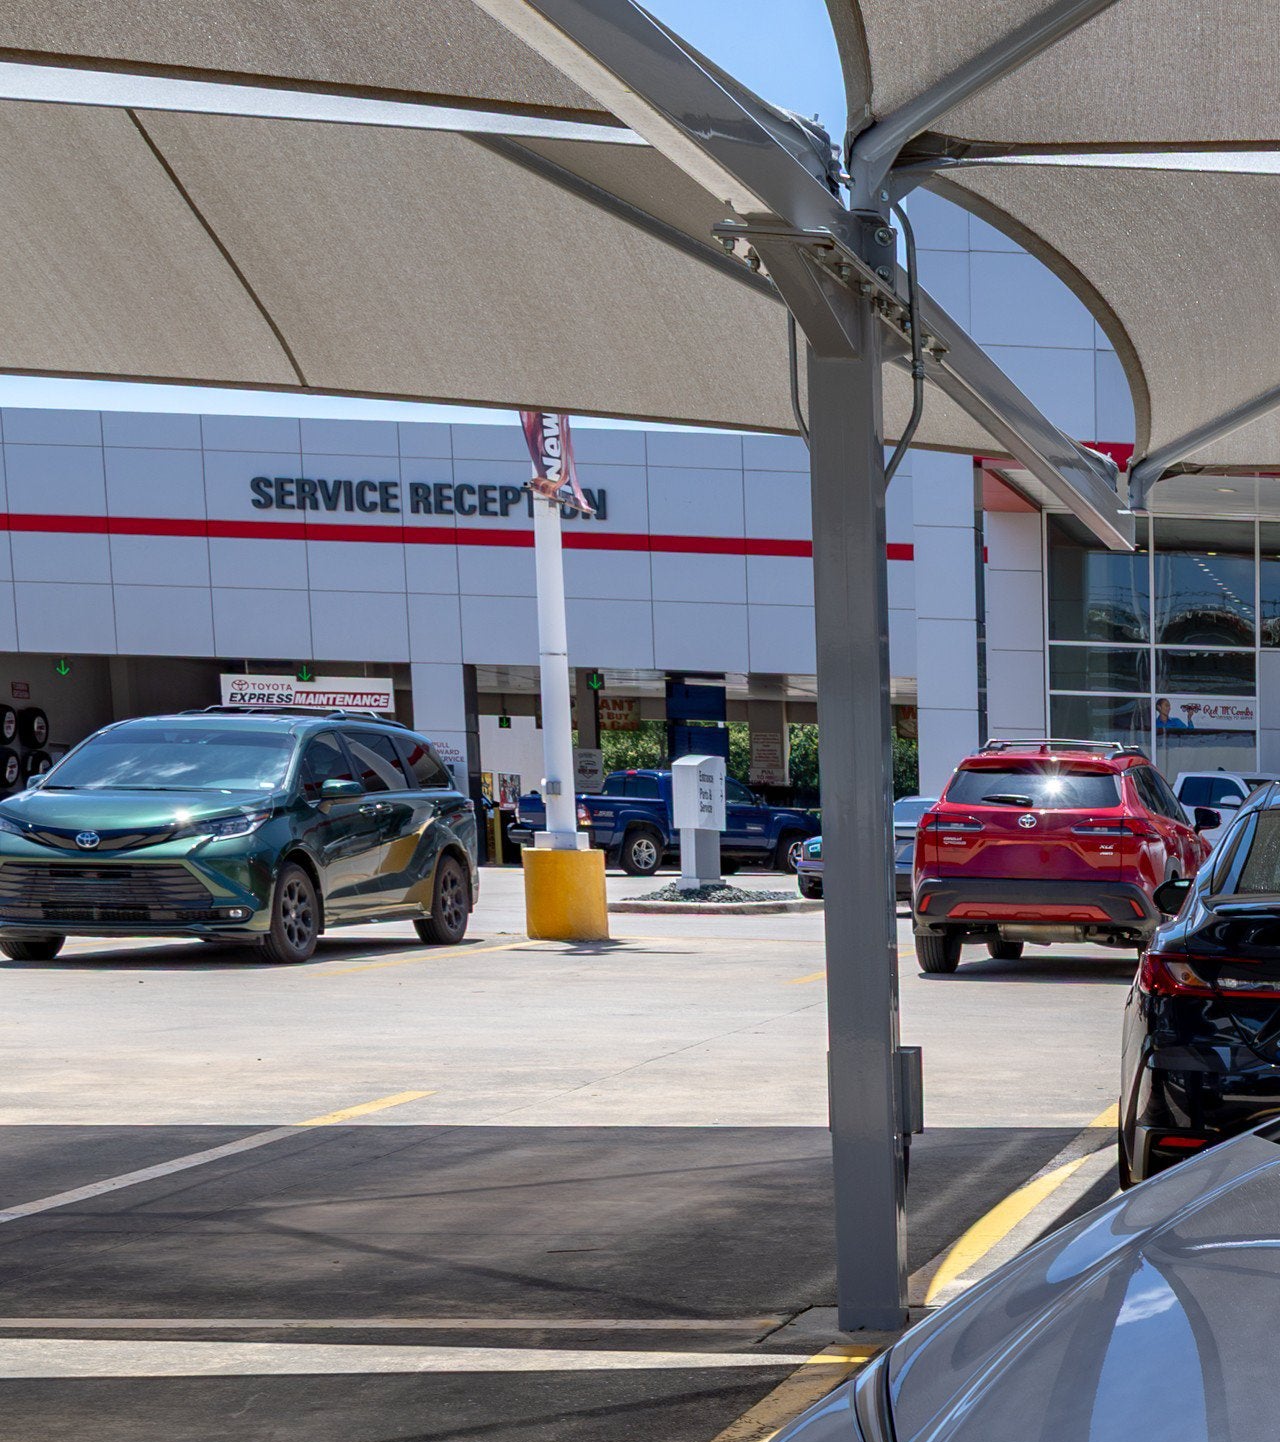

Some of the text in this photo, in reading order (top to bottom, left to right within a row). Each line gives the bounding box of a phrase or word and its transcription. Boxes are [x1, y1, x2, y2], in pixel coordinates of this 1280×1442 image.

[250, 476, 400, 514] SERVICE
[251, 682, 292, 691] TOYOTA
[229, 692, 390, 706] EXPRESS MAINTENANCE
[1203, 705, 1218, 718] Red
